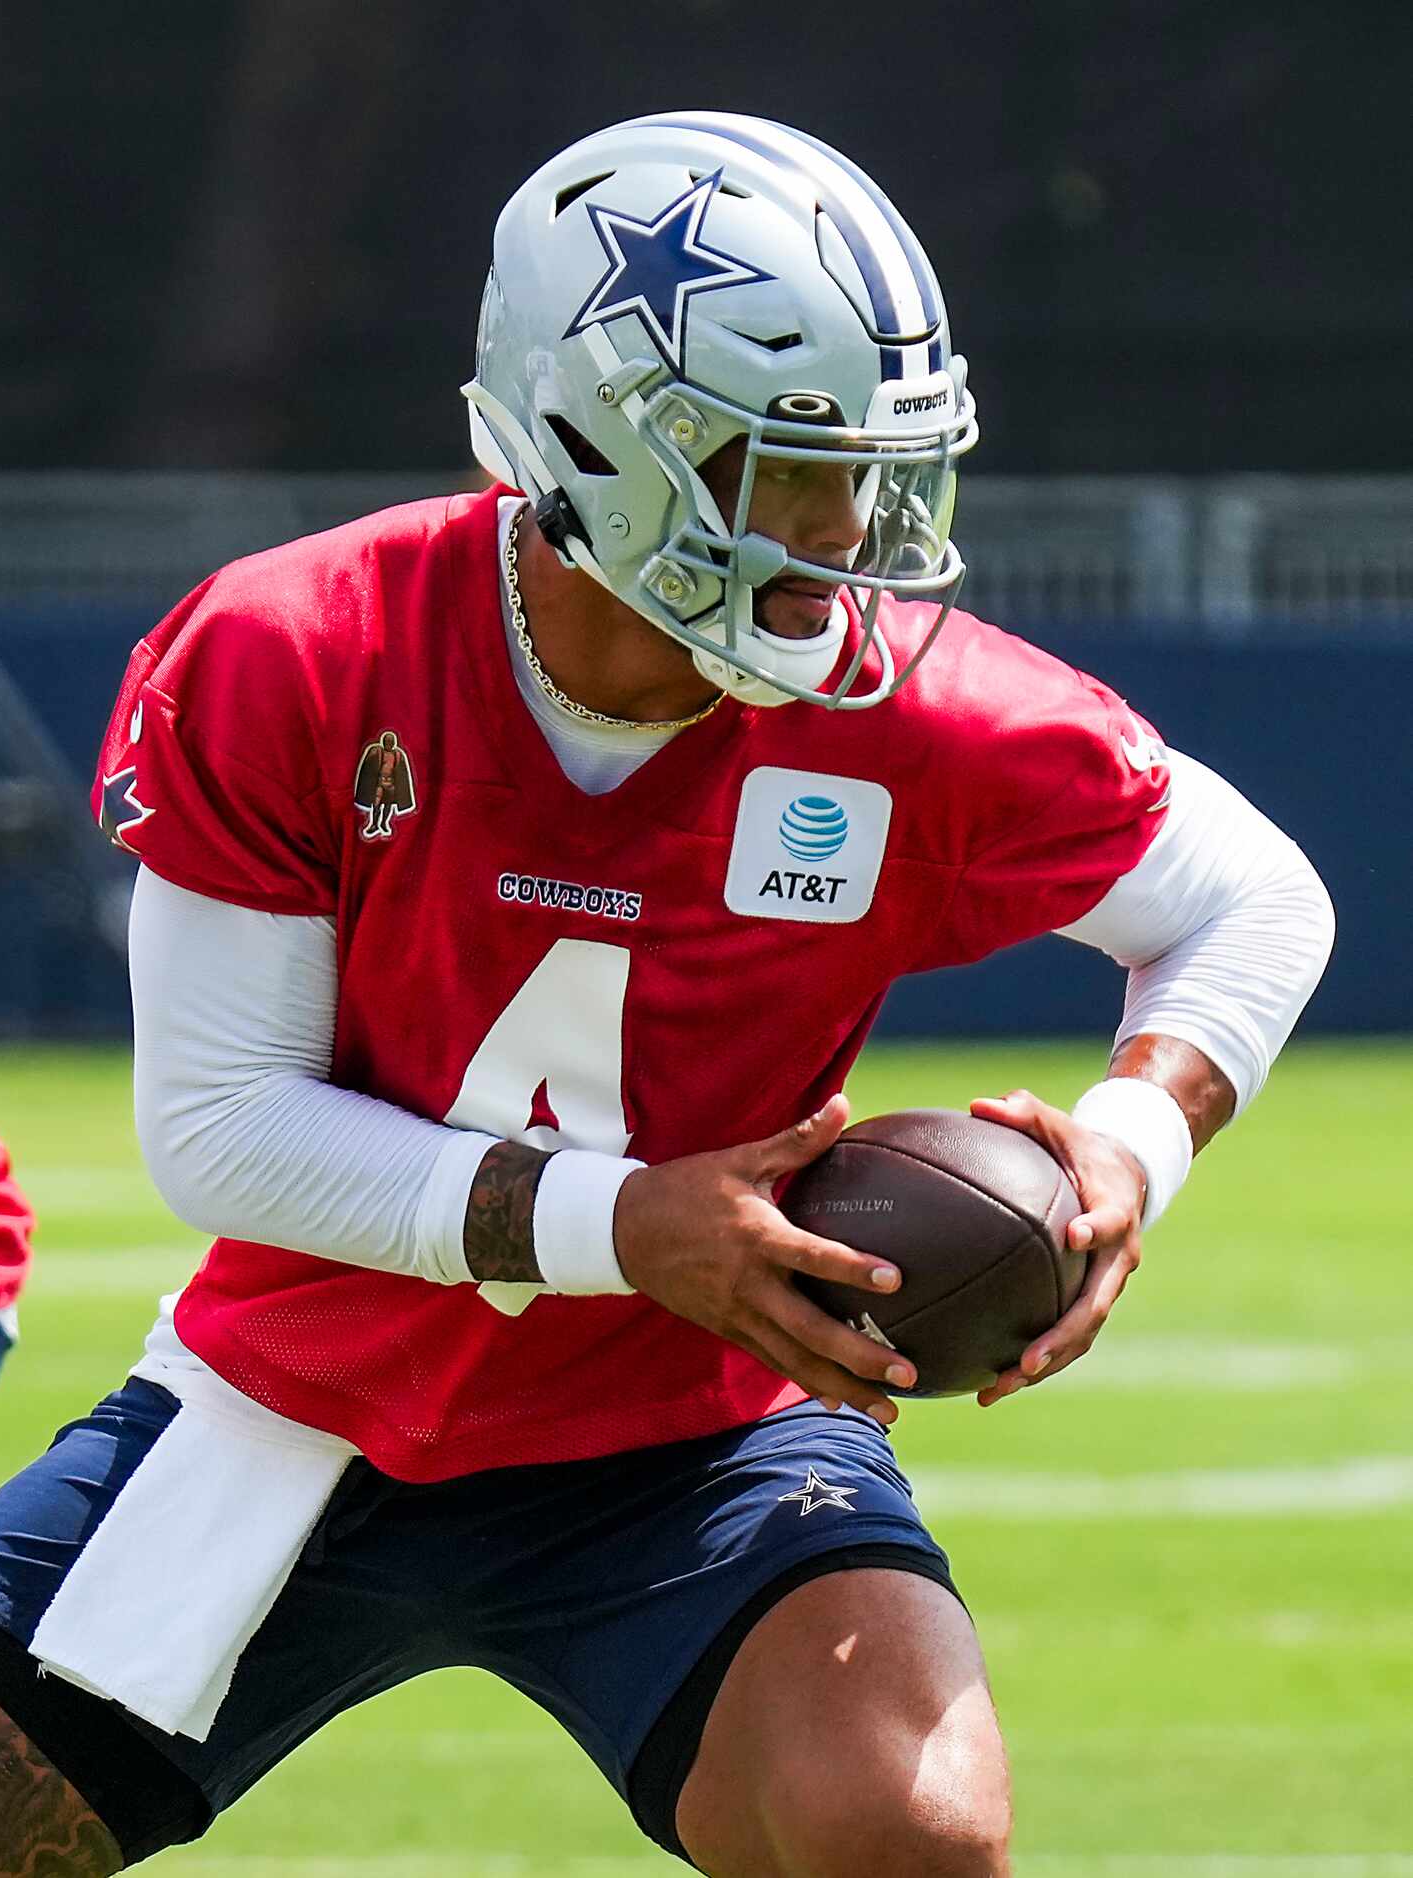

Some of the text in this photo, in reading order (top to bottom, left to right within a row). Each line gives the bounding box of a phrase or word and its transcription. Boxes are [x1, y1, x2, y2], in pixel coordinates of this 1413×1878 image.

[893, 389, 948, 415] COWBOYS
[498, 872, 643, 921] COWBOYS
[758, 869, 848, 905] AT&T
[443, 938, 634, 1316] 4
[826, 1199, 895, 1214] NATIONAL
